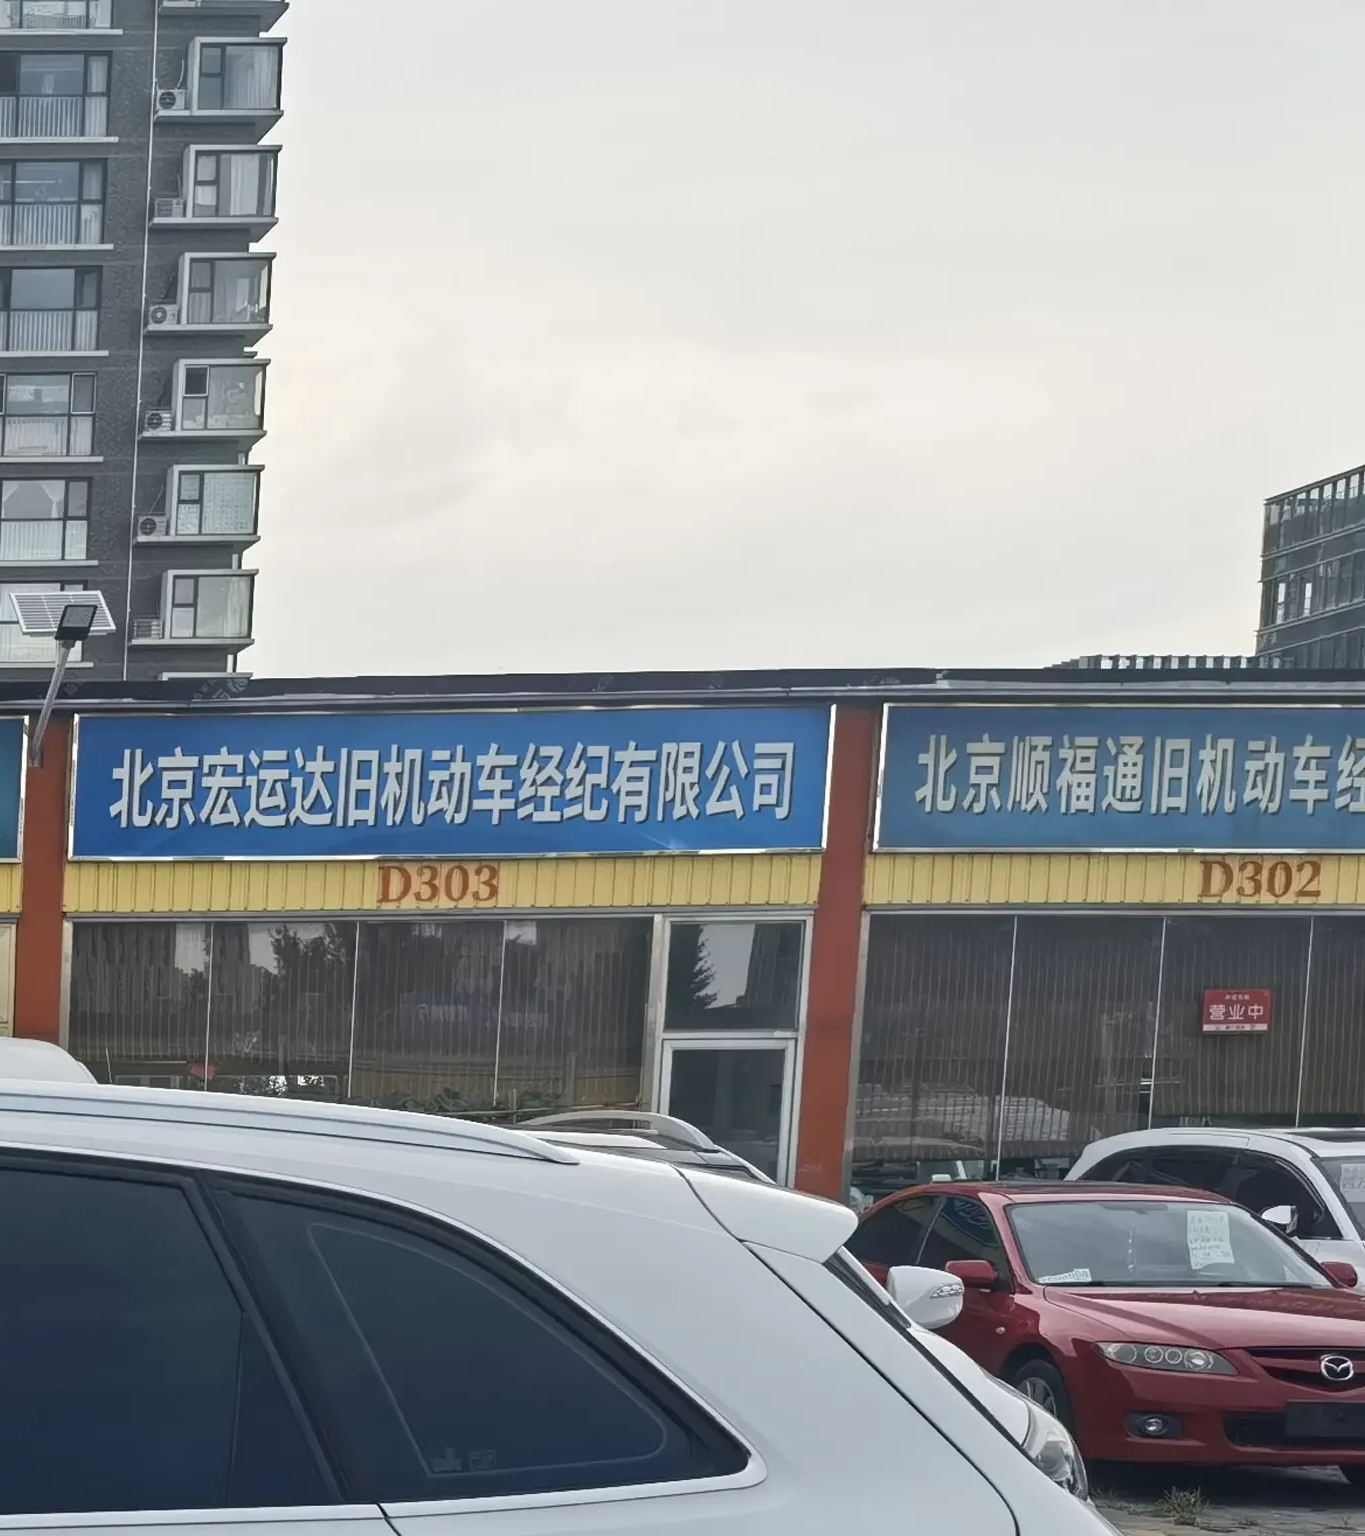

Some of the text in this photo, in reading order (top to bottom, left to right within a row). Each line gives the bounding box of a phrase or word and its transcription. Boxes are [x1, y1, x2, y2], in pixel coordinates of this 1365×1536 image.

[110, 741, 795, 829] 北京宏运达旧机动车经纪有限公司
[377, 864, 500, 904] D303
[1197, 859, 1323, 899] D302
[1208, 1003, 1264, 1021] 营业中
